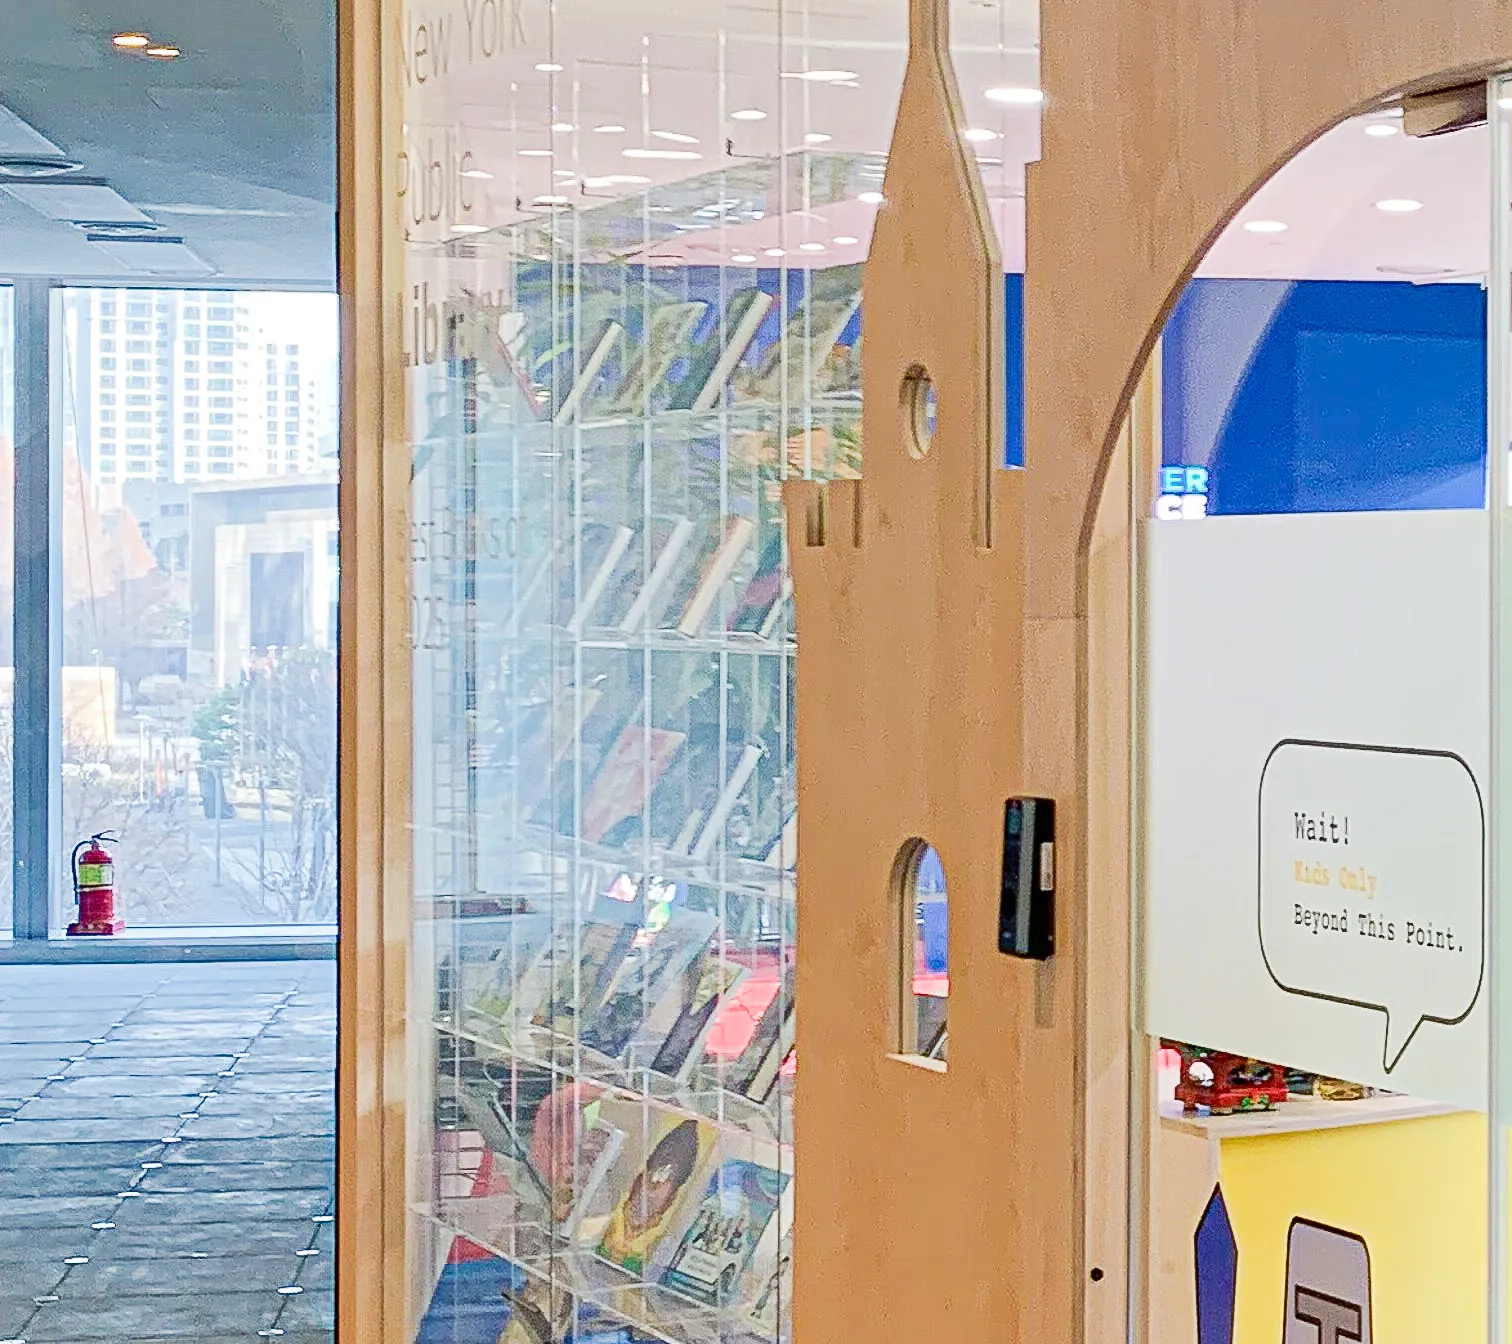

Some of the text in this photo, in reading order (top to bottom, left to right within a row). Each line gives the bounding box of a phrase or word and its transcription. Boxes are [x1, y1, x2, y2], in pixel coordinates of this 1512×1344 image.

[1295, 812, 1349, 844] Wait!
[1294, 903, 1463, 952] Beyond This Point.
